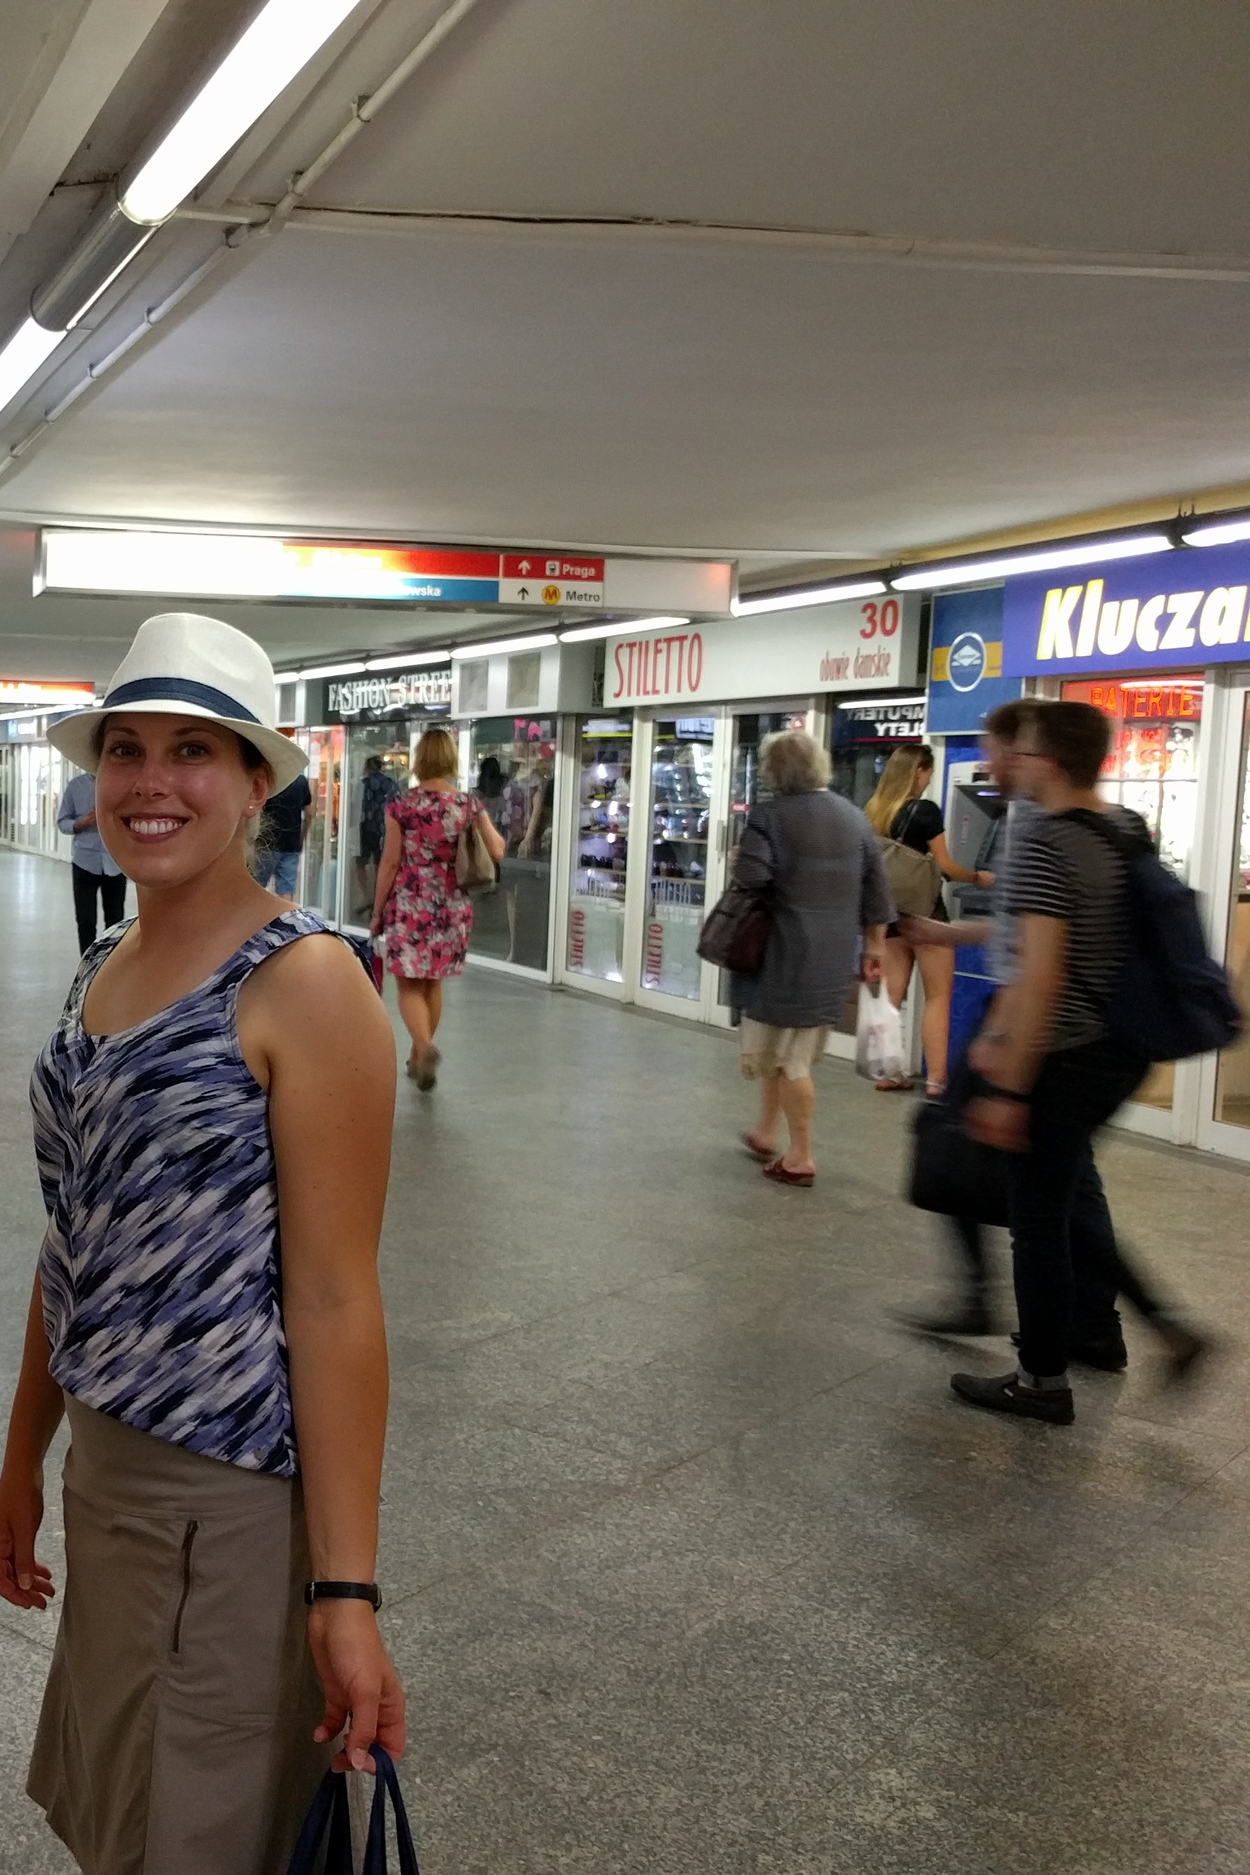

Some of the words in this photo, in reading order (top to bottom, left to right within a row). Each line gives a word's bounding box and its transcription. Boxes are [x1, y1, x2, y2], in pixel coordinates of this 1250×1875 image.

[562, 564, 596, 578] Praga
[565, 590, 601, 603] Metro
[859, 600, 899, 639] 30
[1036, 579, 1250, 660] Klucza
[613, 632, 702, 699] STILETTO
[854, 645, 891, 680] damskie
[328, 677, 392, 711] FASHION
[570, 910, 585, 969] STILETTO
[645, 923, 663, 985] STILETTO
